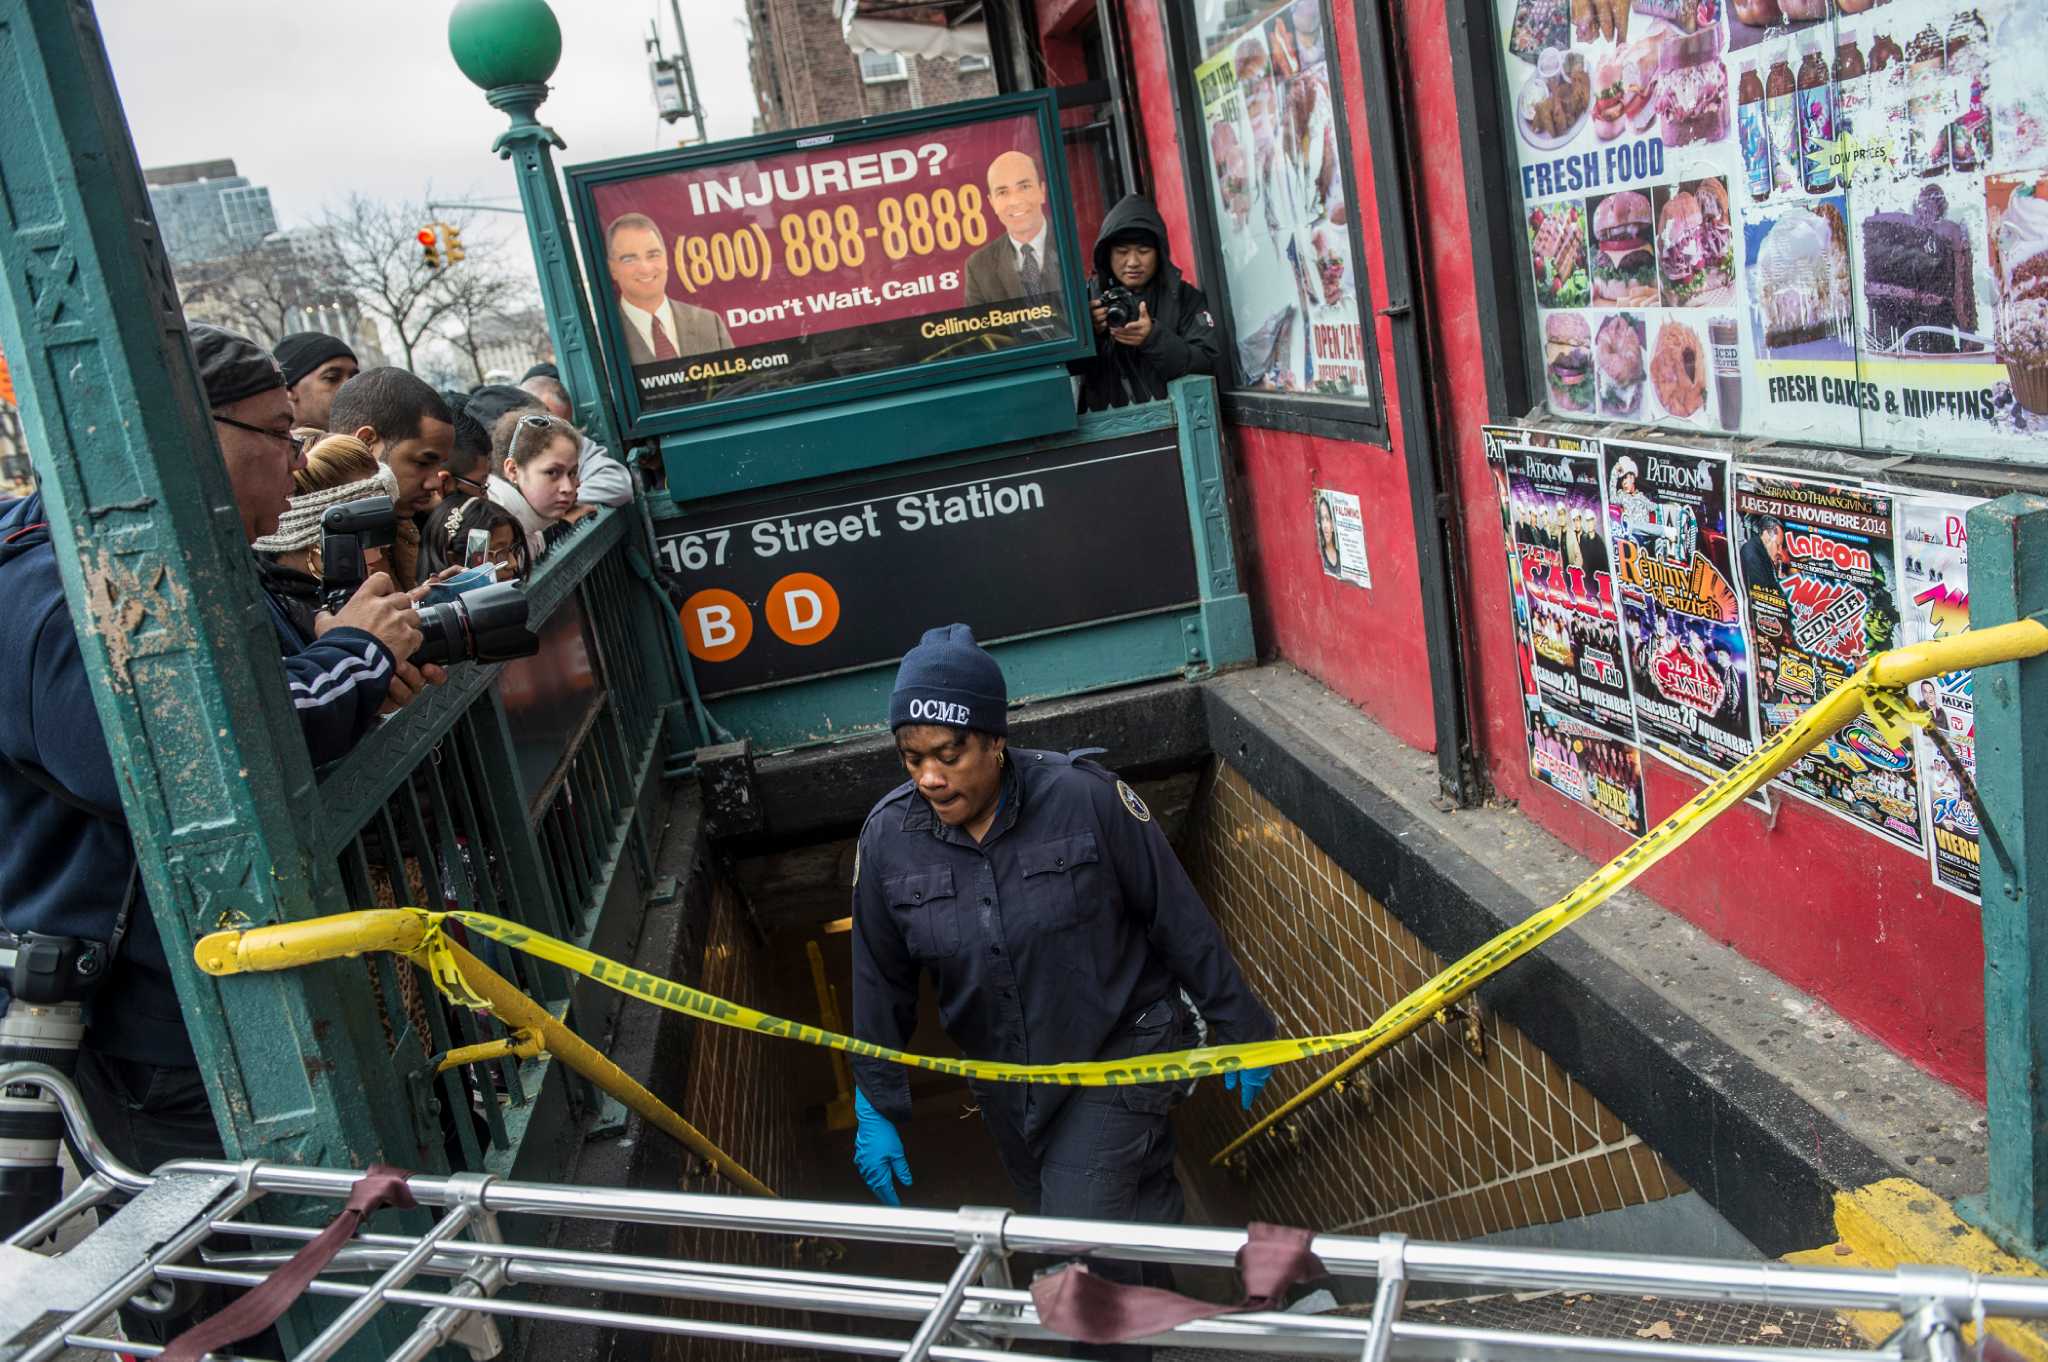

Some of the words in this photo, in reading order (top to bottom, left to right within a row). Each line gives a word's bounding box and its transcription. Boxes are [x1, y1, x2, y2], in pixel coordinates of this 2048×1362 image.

[689, 143, 948, 216] INJURED?
[1522, 152, 1600, 199] FRESH
[1605, 137, 1664, 185] FOOD
[674, 222, 772, 294] (800)
[780, 183, 988, 278] 888-8888
[727, 298, 804, 328] Don't
[881, 274, 936, 302] Call
[938, 270, 958, 291] 8
[1314, 324, 1341, 359] OPEN
[1341, 323, 1354, 360] 24
[1714, 347, 1738, 359] ICED
[641, 350, 789, 391] www.CALL8.com
[1769, 375, 1817, 403] FRESH
[1822, 377, 1880, 412] CAKES
[1885, 390, 1899, 415] &
[1903, 387, 1995, 420] MUFFINS
[1646, 456, 1698, 489] PATRON
[1740, 495, 1768, 514] JUEVES
[1769, 503, 1782, 516] 27
[1797, 508, 1859, 531] NOVIEMBRE
[1861, 518, 1887, 535] 2014
[1807, 490, 1872, 513] THANKSGIVING
[660, 530, 731, 573] 167
[751, 504, 881, 558] Street
[896, 482, 1044, 532] Station
[697, 605, 736, 648] B
[784, 588, 823, 631] D
[1801, 593, 1861, 645] CONGA
[1563, 671, 1579, 698] 29
[909, 698, 970, 725] OCME
[1680, 704, 1698, 732] 26
[1697, 718, 1753, 755] NOVIEMBRE
